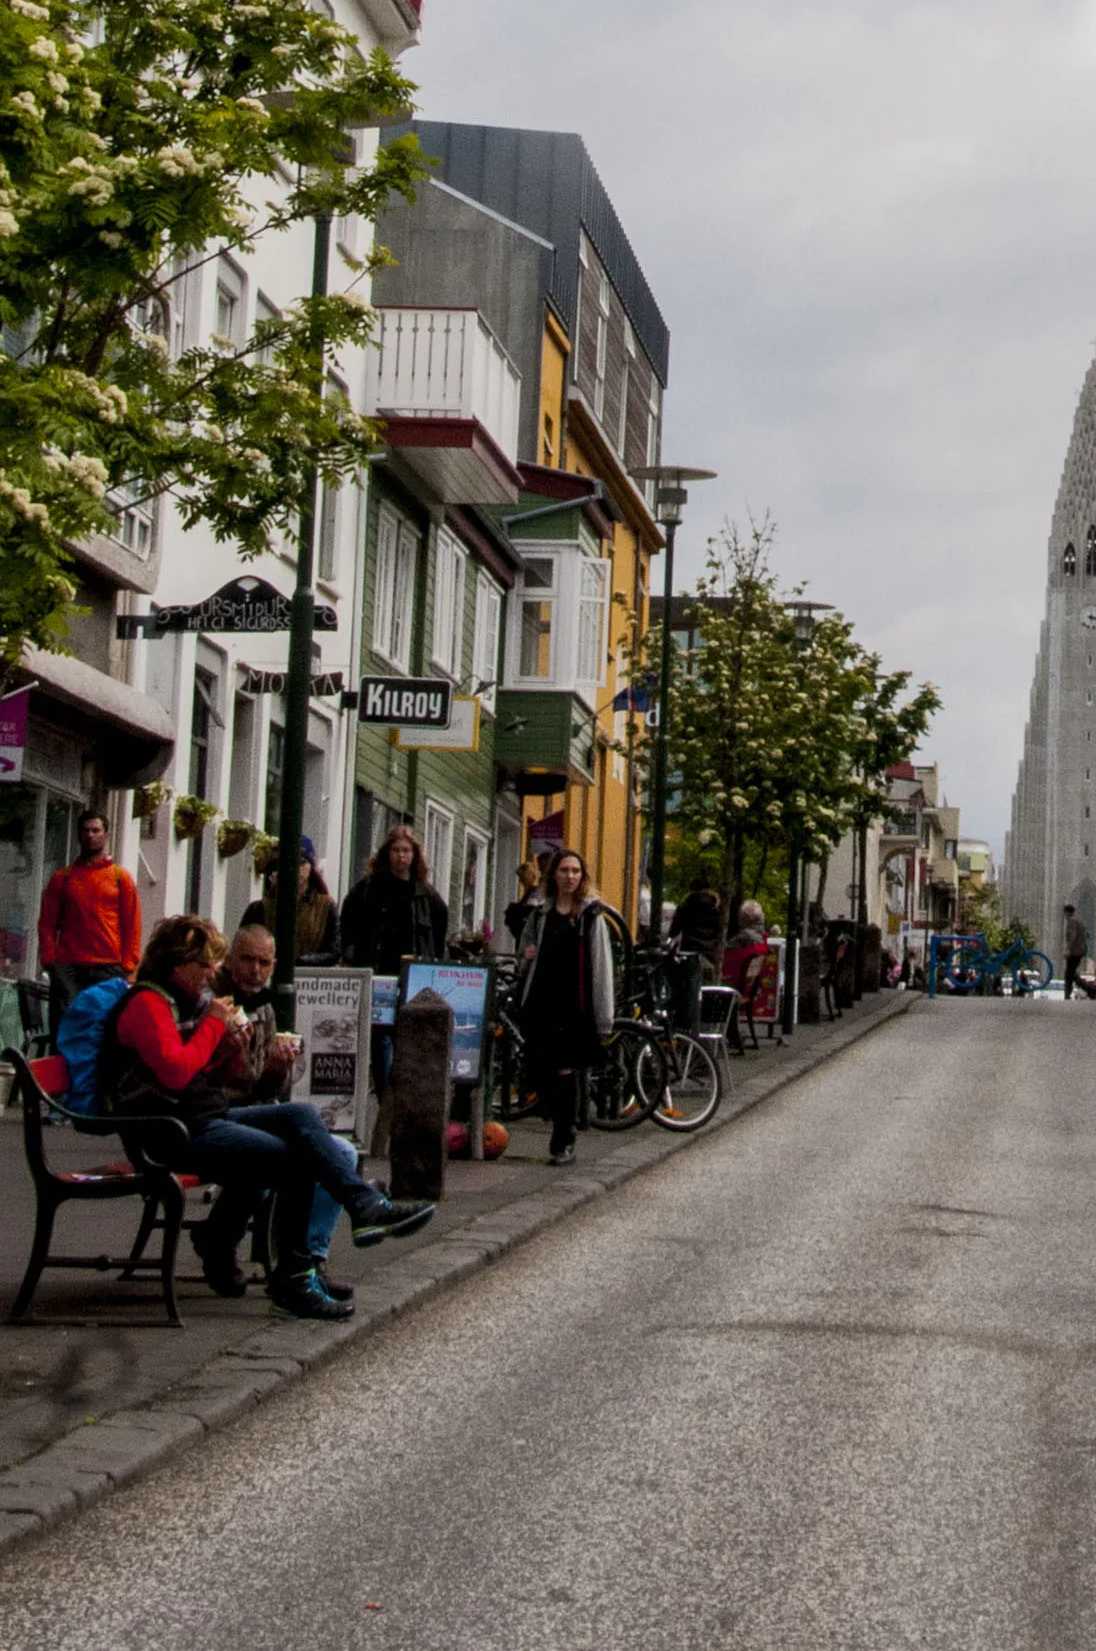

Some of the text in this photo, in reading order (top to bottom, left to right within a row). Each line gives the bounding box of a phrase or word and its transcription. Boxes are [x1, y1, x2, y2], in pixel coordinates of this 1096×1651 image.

[248, 669, 338, 697] MOKA
[365, 682, 443, 720] KILROY
[294, 978, 360, 992] andmade
[297, 992, 360, 1009] ewellery
[314, 1056, 353, 1069] ANNA
